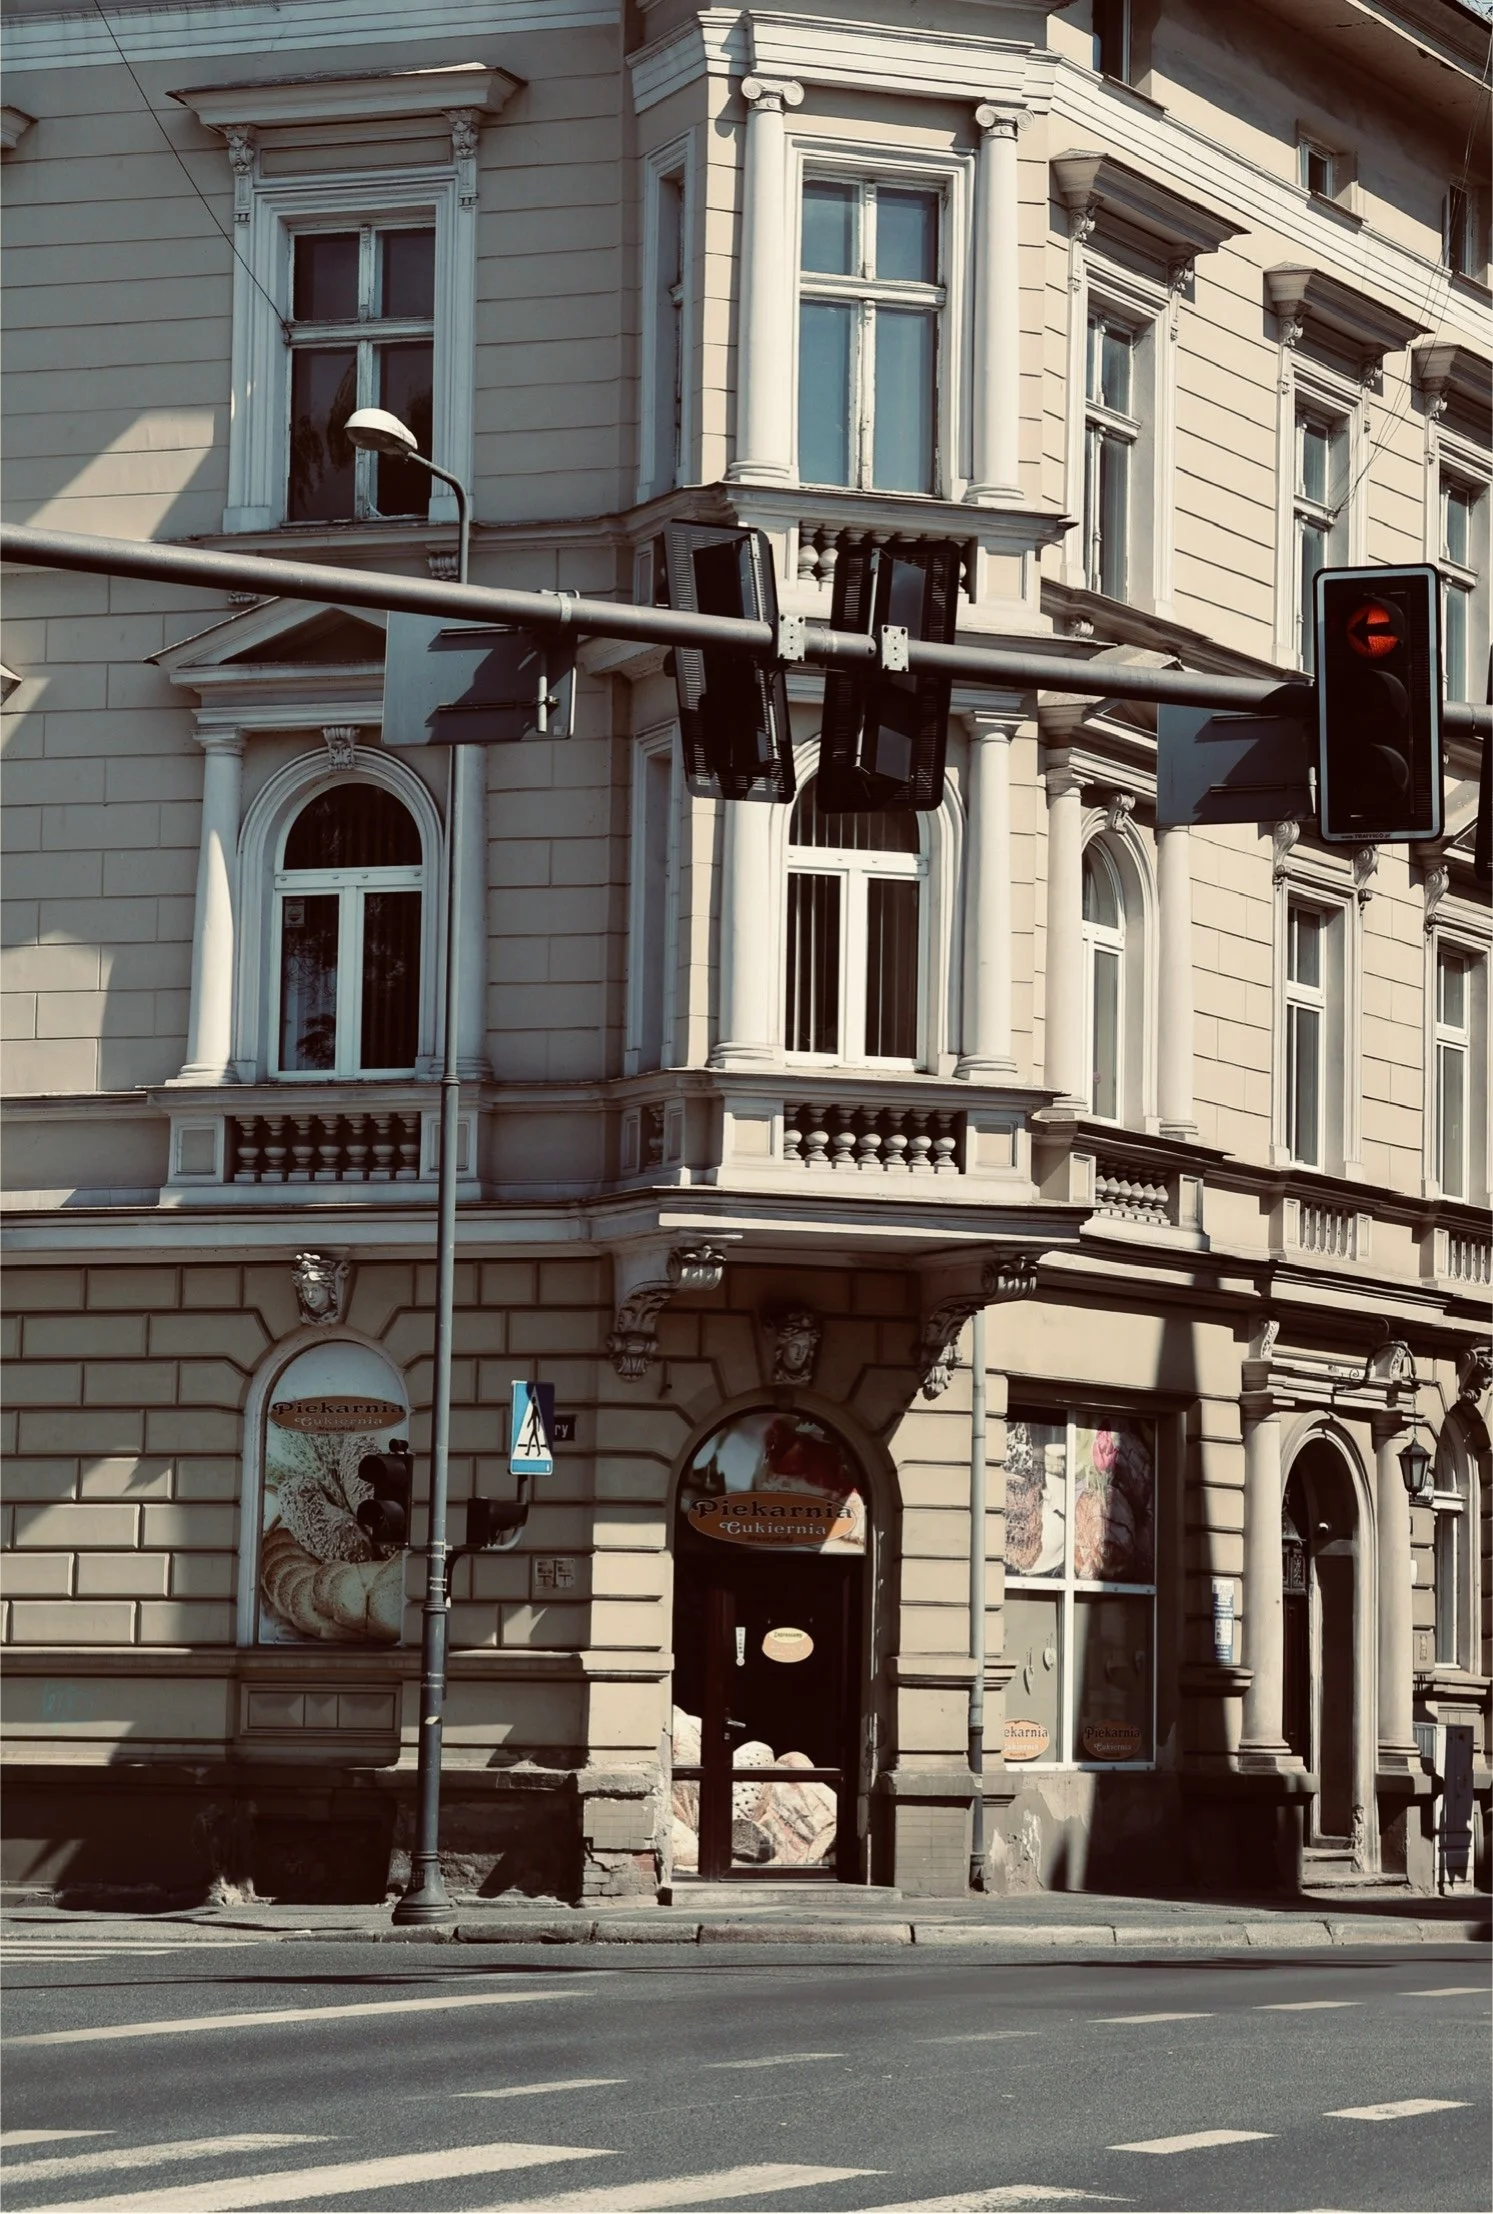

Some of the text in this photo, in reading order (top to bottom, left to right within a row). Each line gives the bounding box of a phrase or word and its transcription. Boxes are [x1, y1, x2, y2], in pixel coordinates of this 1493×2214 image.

[272, 1401, 404, 1414] Piekarnia
[295, 1416, 382, 1427] Cukiernia
[554, 1424, 568, 1438] ry
[691, 1500, 852, 1518] Piekarnia
[719, 1521, 827, 1535] Cukiernia
[1004, 1726, 1048, 1738] ekarnia
[1085, 1726, 1140, 1739] Piekarnia
